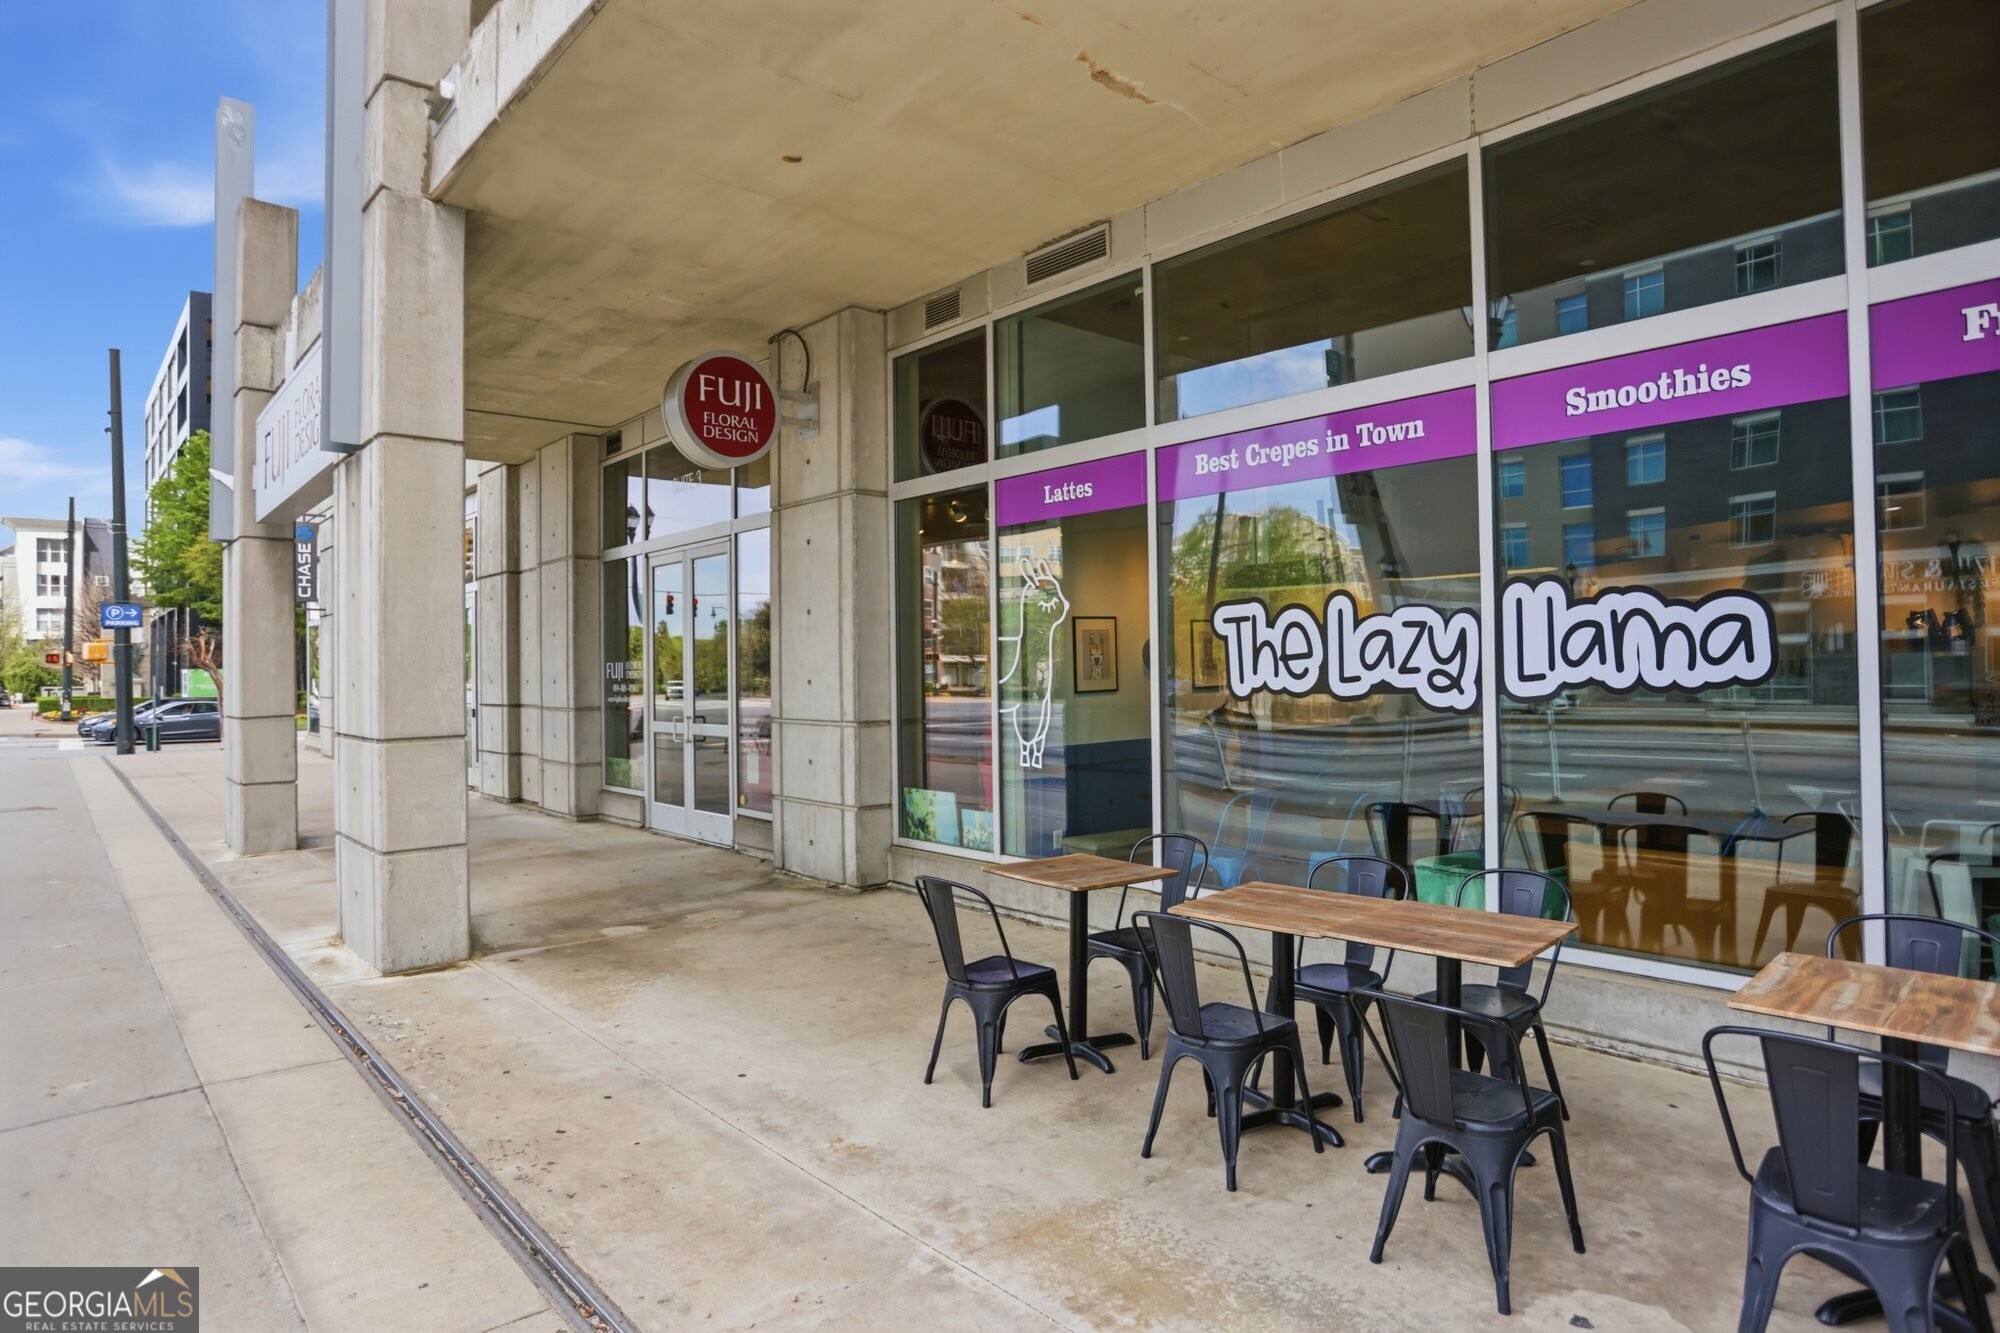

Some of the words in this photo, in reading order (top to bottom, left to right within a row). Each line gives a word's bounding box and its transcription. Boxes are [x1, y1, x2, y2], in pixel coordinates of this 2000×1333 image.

[699, 374, 761, 413] FUJI
[1565, 363, 1753, 417] Smoothies
[295, 413, 320, 464] DESIG
[703, 411, 758, 430] FLORAL
[703, 425, 759, 443] DESIGN
[264, 409, 290, 490] FUJI
[1195, 449, 1239, 476] Best
[1245, 438, 1319, 470] Crepes
[1325, 429, 1350, 453] in
[1356, 418, 1425, 447] Town
[1044, 479, 1093, 504] Lattes
[297, 543, 311, 598] CHASE
[1215, 607, 1320, 694] The
[1330, 599, 1476, 705] Lazy
[1506, 583, 1769, 691] Llama
